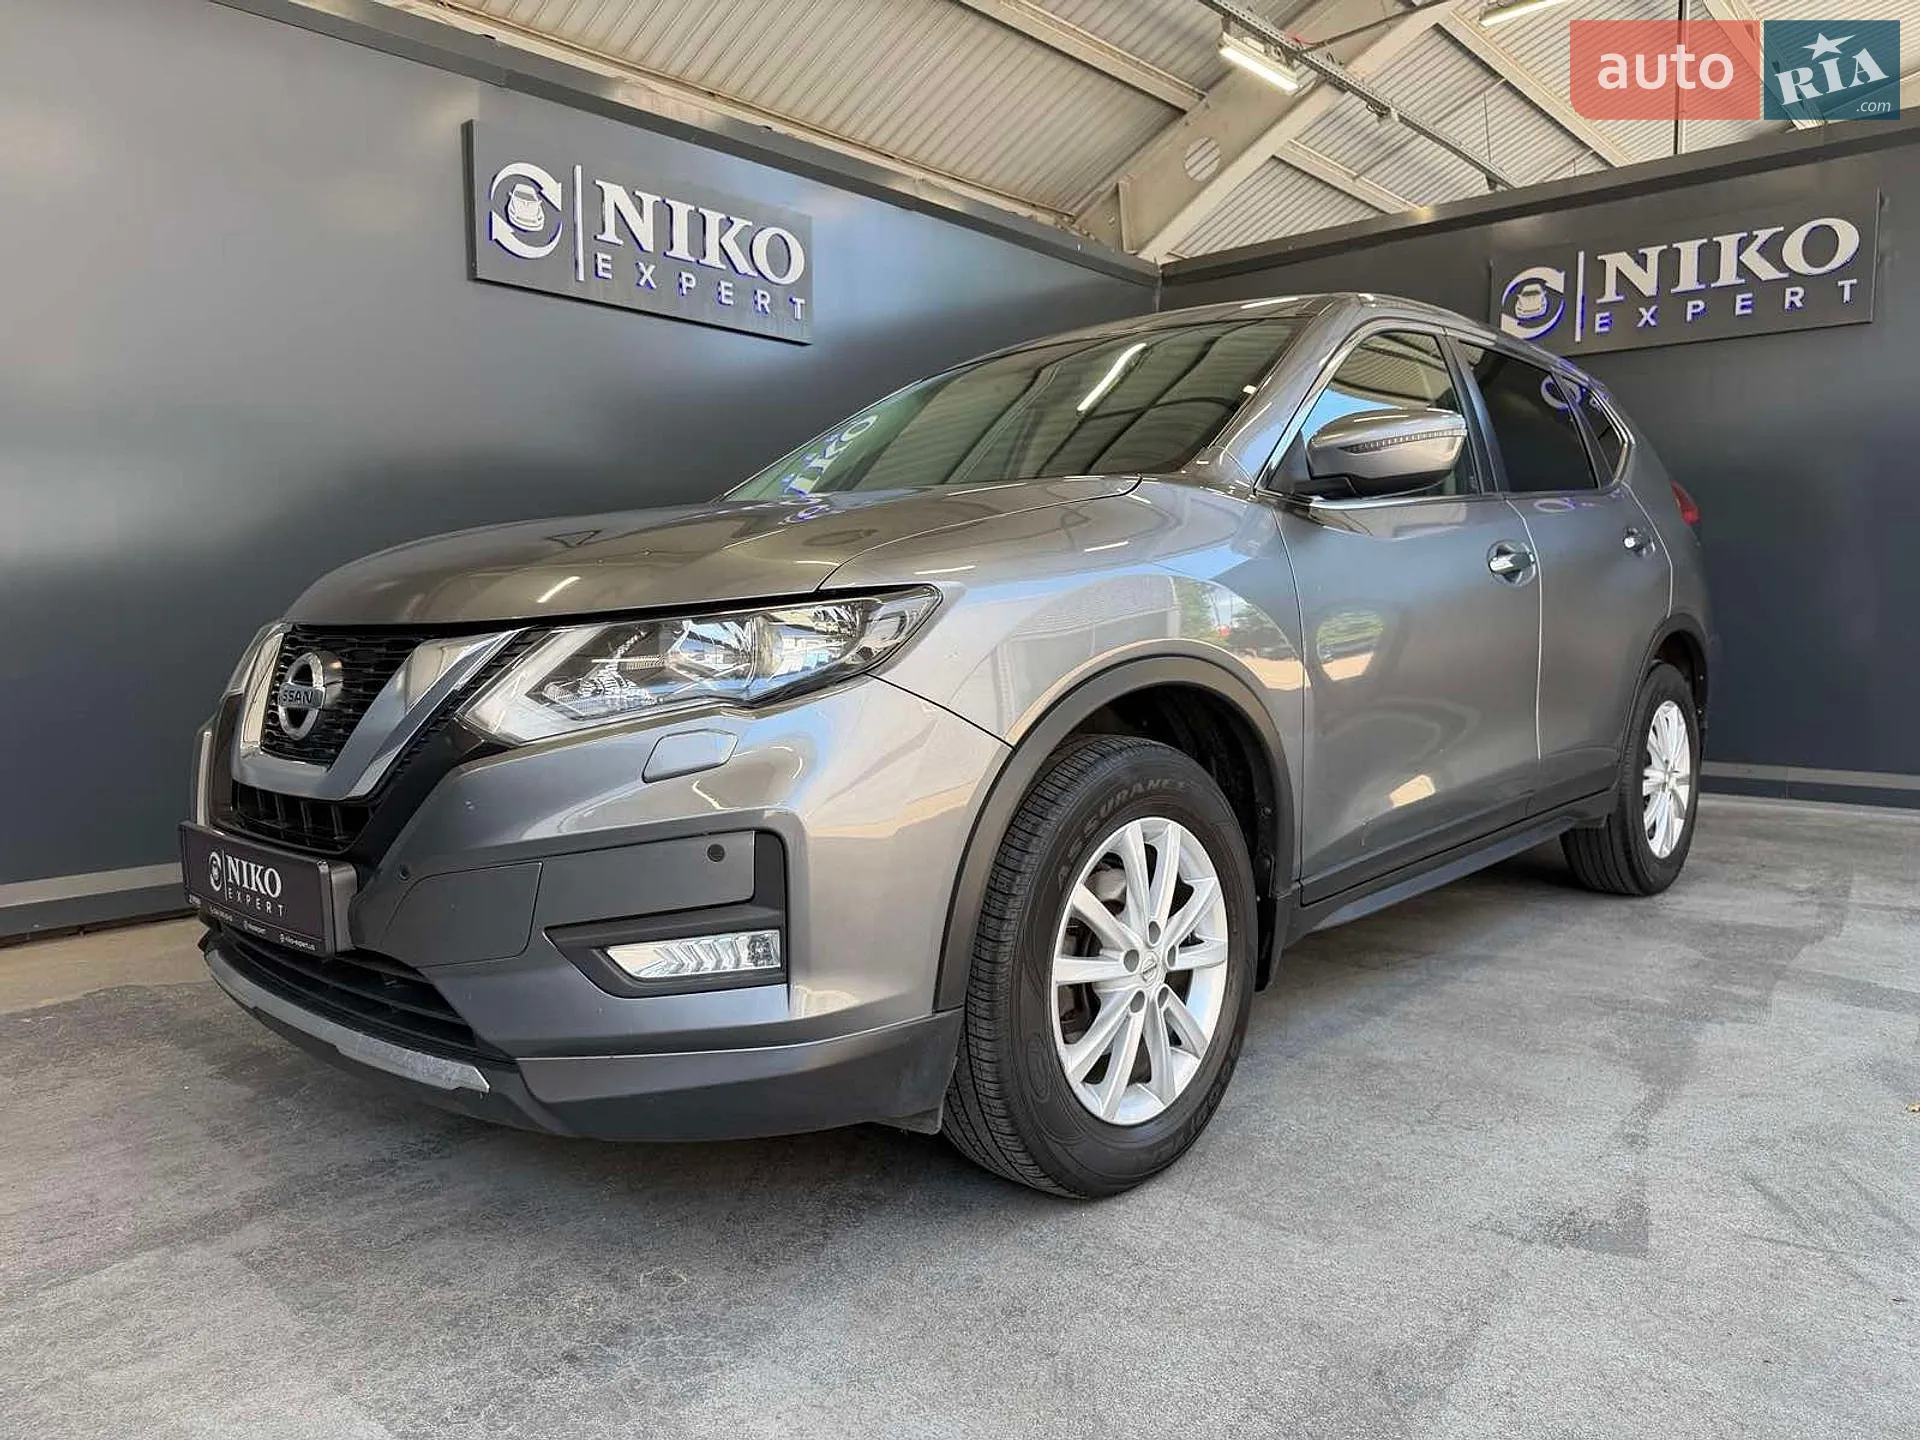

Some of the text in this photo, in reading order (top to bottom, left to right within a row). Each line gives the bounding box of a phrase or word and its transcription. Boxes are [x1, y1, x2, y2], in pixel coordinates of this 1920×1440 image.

[594, 179, 806, 285] NIKO
[1595, 216, 1861, 304] NIKO
[595, 252, 806, 320] EXPERT
[1594, 278, 1858, 334] EXPERT
[282, 689, 314, 705] SSAN
[225, 854, 282, 898] NIKO
[227, 887, 286, 918] EXPERT
